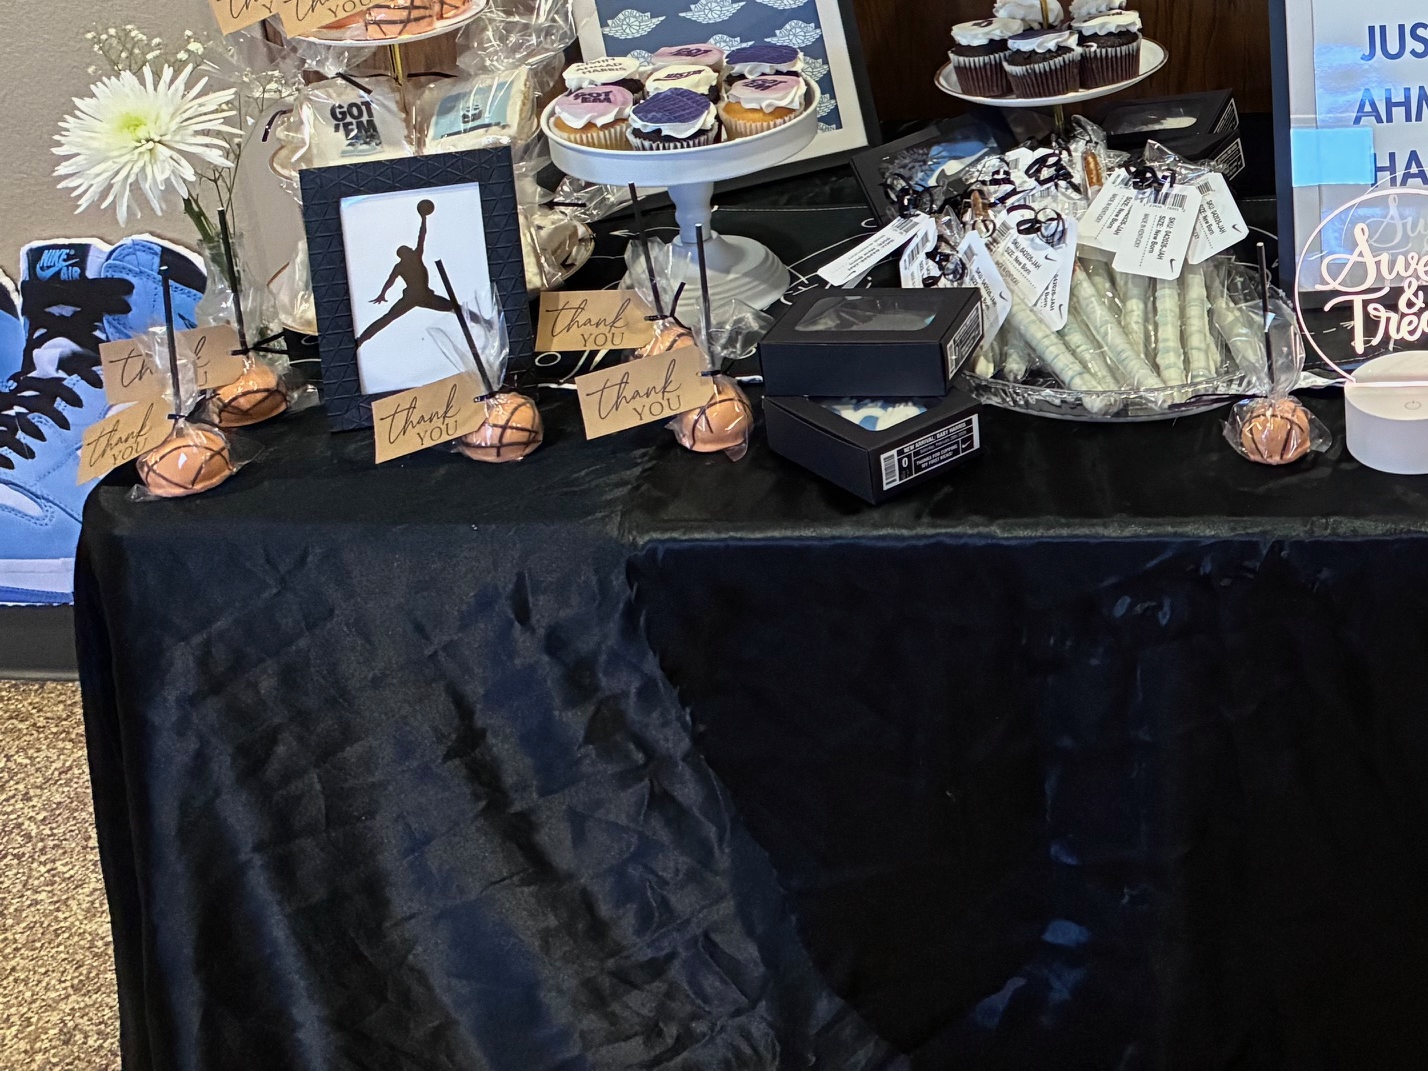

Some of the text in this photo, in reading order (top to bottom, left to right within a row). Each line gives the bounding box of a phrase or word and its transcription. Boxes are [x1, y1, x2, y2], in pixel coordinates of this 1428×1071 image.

[330, 100, 375, 123] GOT
[1107, 217, 1119, 229] Born
[1149, 215, 1166, 254] SIZE: New Born
[1167, 216, 1176, 230] SKU:
[40, 249, 69, 267] NIKE
[1020, 264, 1032, 276] Born
[60, 266, 81, 281] AIR
[1399, 278, 1426, 315] &
[545, 298, 631, 338] thank
[581, 332, 624, 347] YOU
[586, 359, 682, 420] thank
[380, 384, 461, 444] thank
[632, 395, 681, 421] YOU
[87, 403, 154, 468] thank
[417, 420, 457, 446] YOU
[110, 438, 147, 465] YOU
[902, 458, 909, 467] 0
